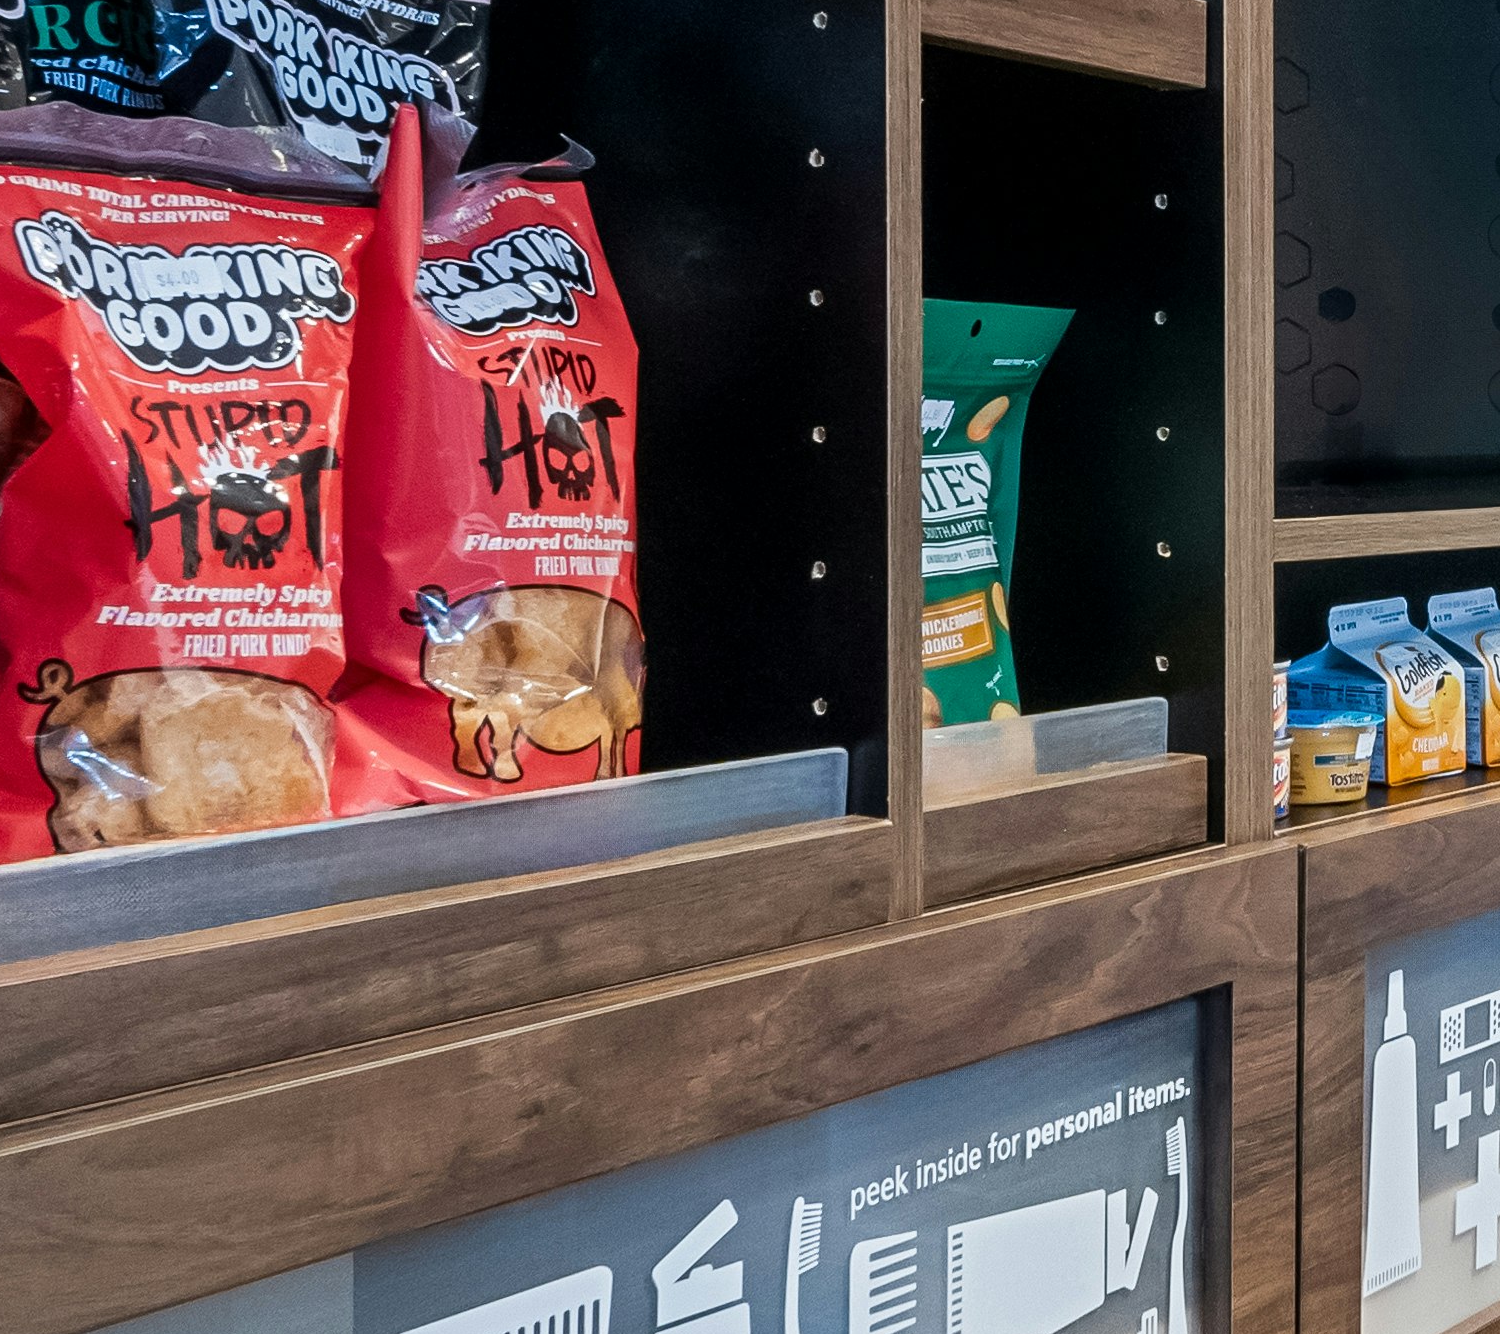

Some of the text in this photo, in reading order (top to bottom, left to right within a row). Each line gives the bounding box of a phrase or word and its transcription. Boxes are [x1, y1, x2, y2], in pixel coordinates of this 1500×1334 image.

[334, 36, 436, 101] KING
[45, 71, 89, 92] FRIED
[276, 58, 389, 126] GOOD
[8, 176, 325, 226] GRAMS TOTAL CARBOHYDRATES
[101, 207, 231, 226] PER SERVING!
[155, 271, 200, 288] $4.00
[111, 300, 272, 350] GOOD
[166, 376, 260, 395] Presents
[131, 398, 312, 448] STUPID
[506, 513, 630, 533] Extremely Spicy
[464, 533, 561, 554] Flavored
[535, 556, 594, 576] FRIED PORK
[151, 583, 333, 610] Extremely Spicy
[97, 604, 222, 628] Flavored
[184, 634, 311, 656] FRIED PORK RINDS
[1395, 648, 1449, 695] Goldfish
[1412, 731, 1449, 754] CHEDDAR
[850, 1077, 1191, 1221] peek inside for personal items.
